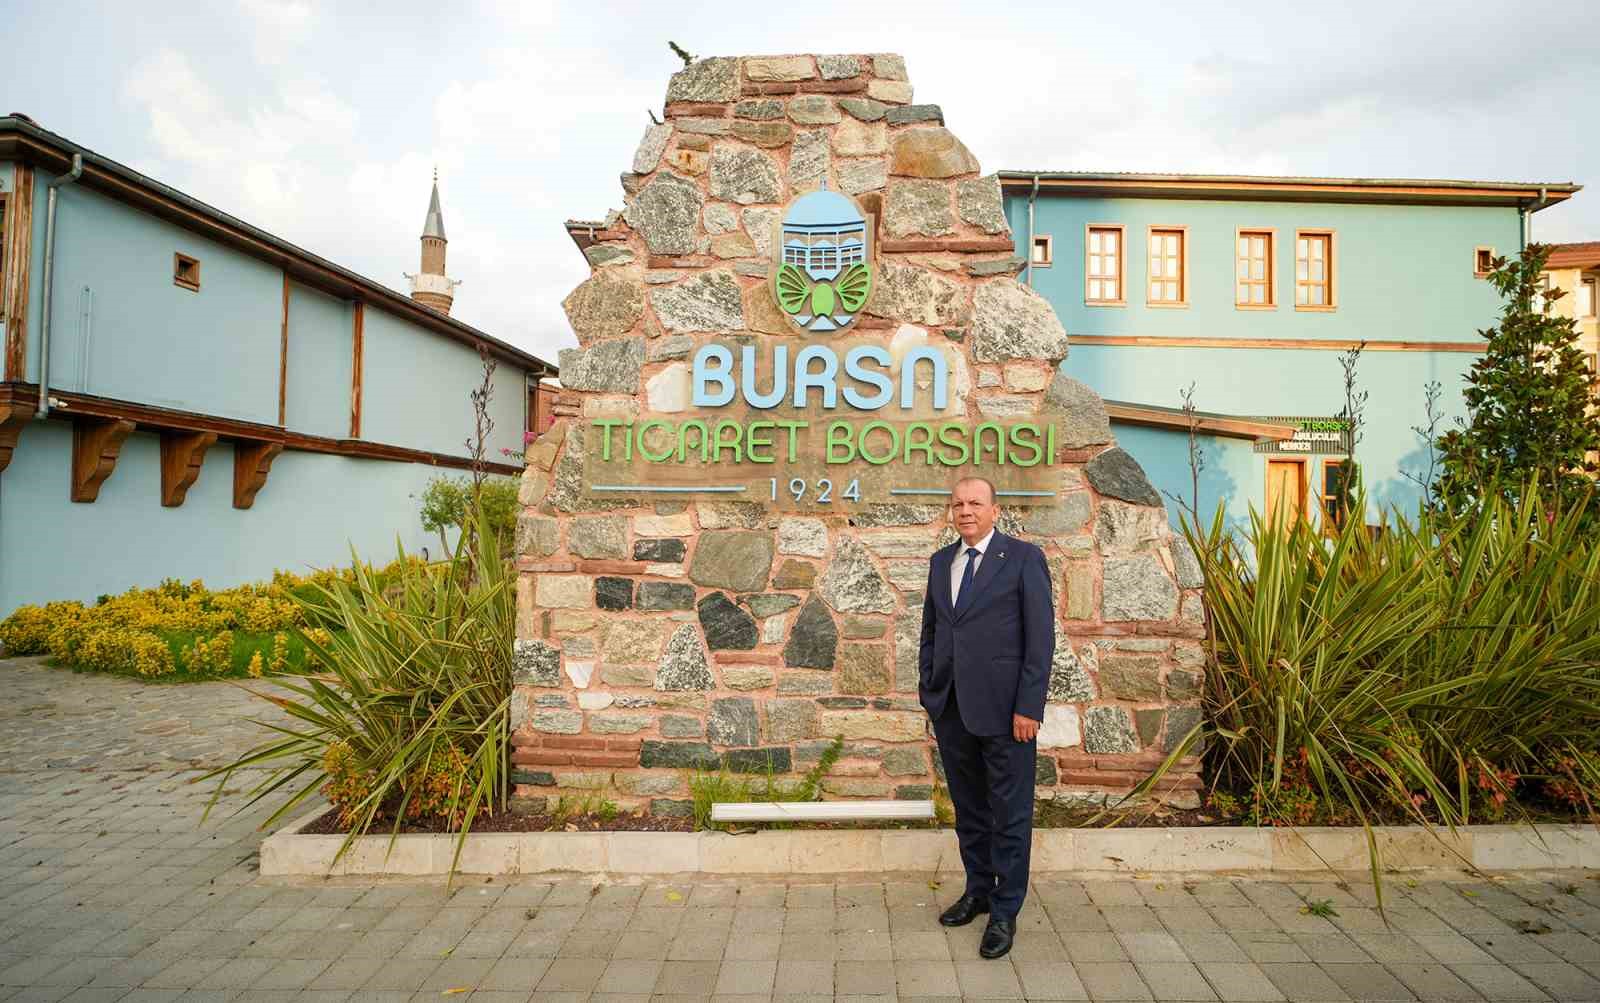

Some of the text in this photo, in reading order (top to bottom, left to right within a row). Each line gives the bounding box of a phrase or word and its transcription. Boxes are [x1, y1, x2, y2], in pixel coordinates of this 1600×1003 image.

[693, 345, 948, 410] BURSA
[592, 417, 1056, 468] TİCARET BORSASI
[769, 477, 863, 504] 1924
